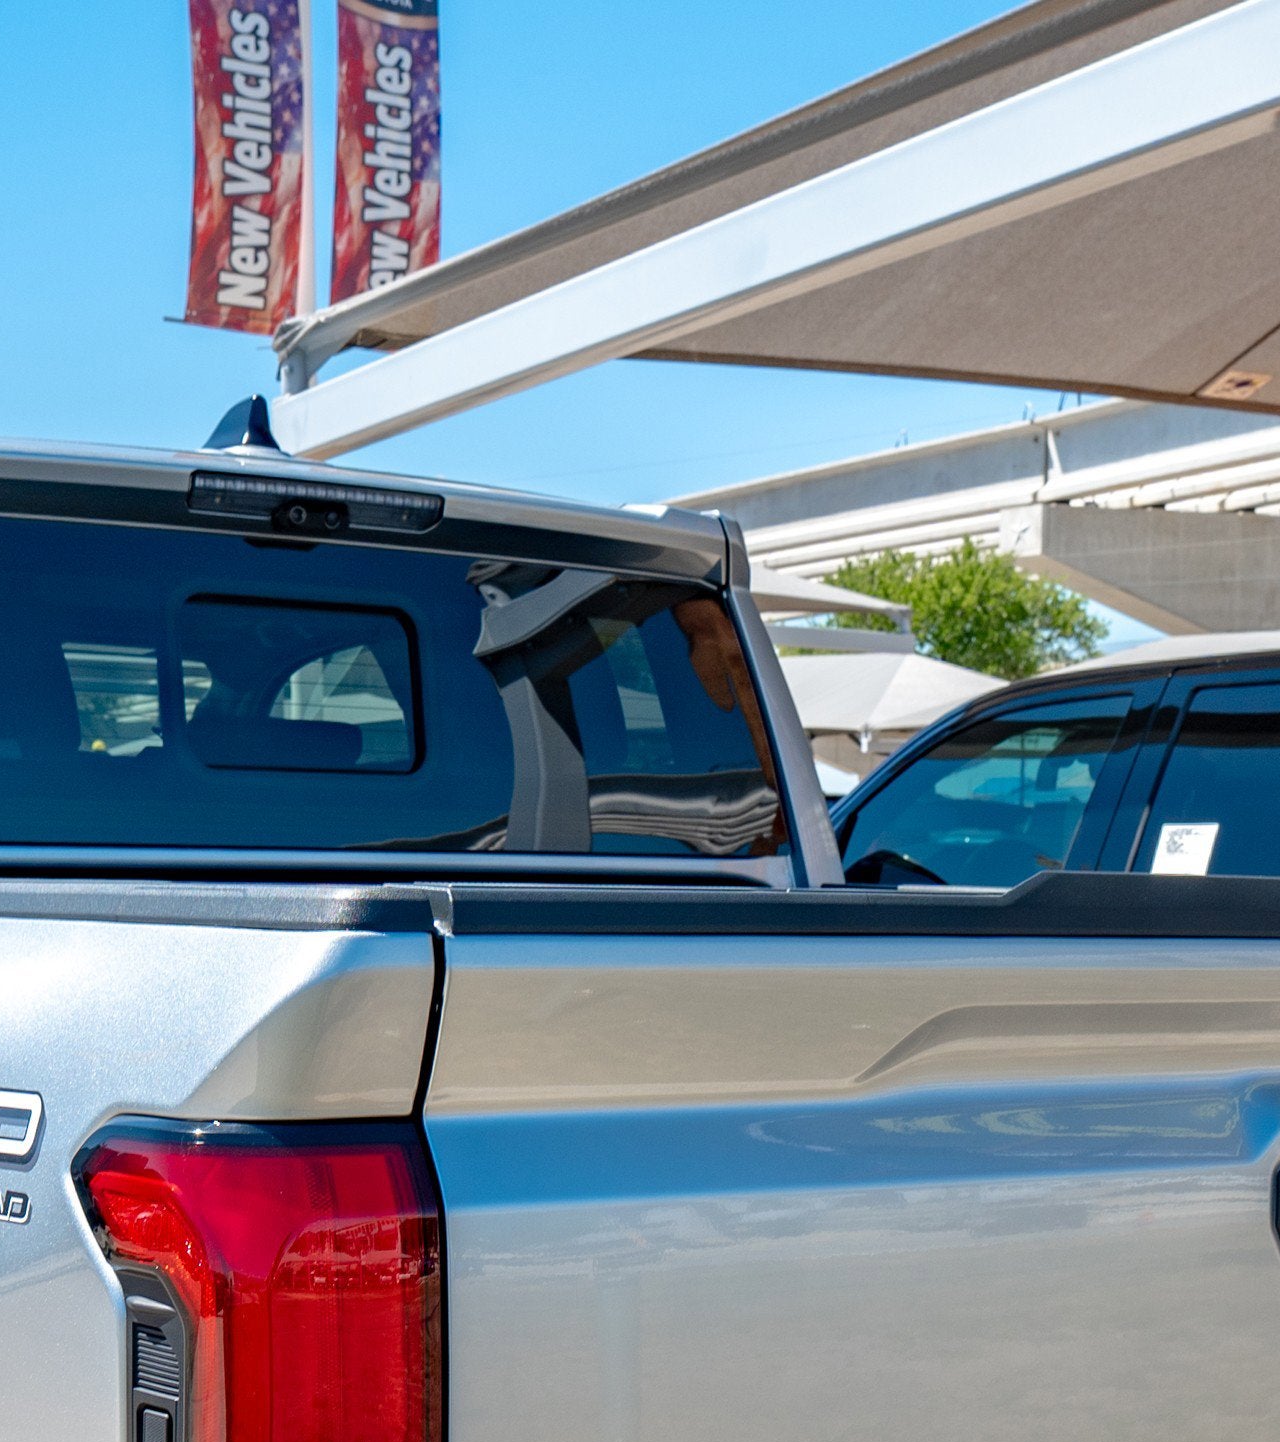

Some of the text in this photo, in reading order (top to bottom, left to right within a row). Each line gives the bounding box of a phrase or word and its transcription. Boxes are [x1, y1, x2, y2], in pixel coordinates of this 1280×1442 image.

[217, 9, 272, 310] New Vehicles
[363, 43, 413, 222] Vehicles
[370, 230, 410, 289] ew
